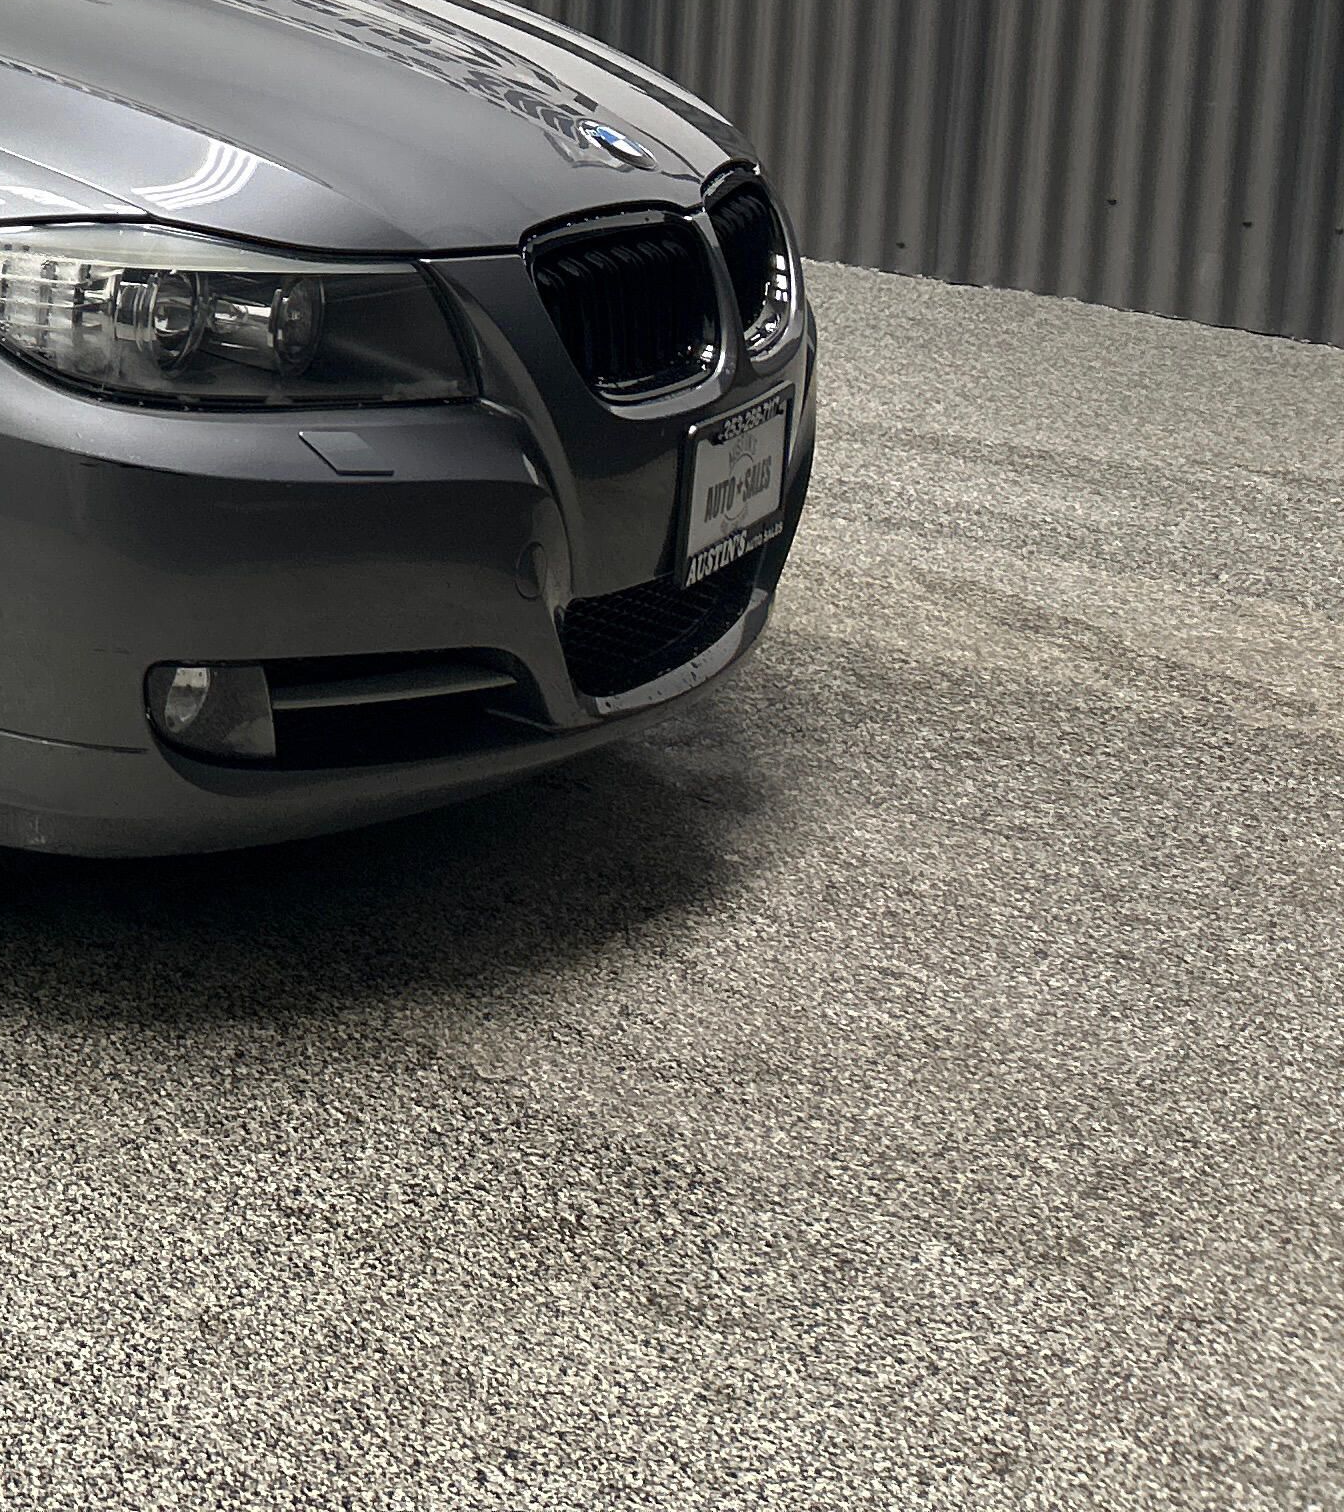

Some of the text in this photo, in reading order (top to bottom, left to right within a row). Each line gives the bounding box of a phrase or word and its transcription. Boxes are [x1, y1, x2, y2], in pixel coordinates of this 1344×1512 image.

[705, 476, 736, 523] AUTO
[743, 456, 772, 503] SALES
[685, 529, 747, 588] AUSTIN'S
